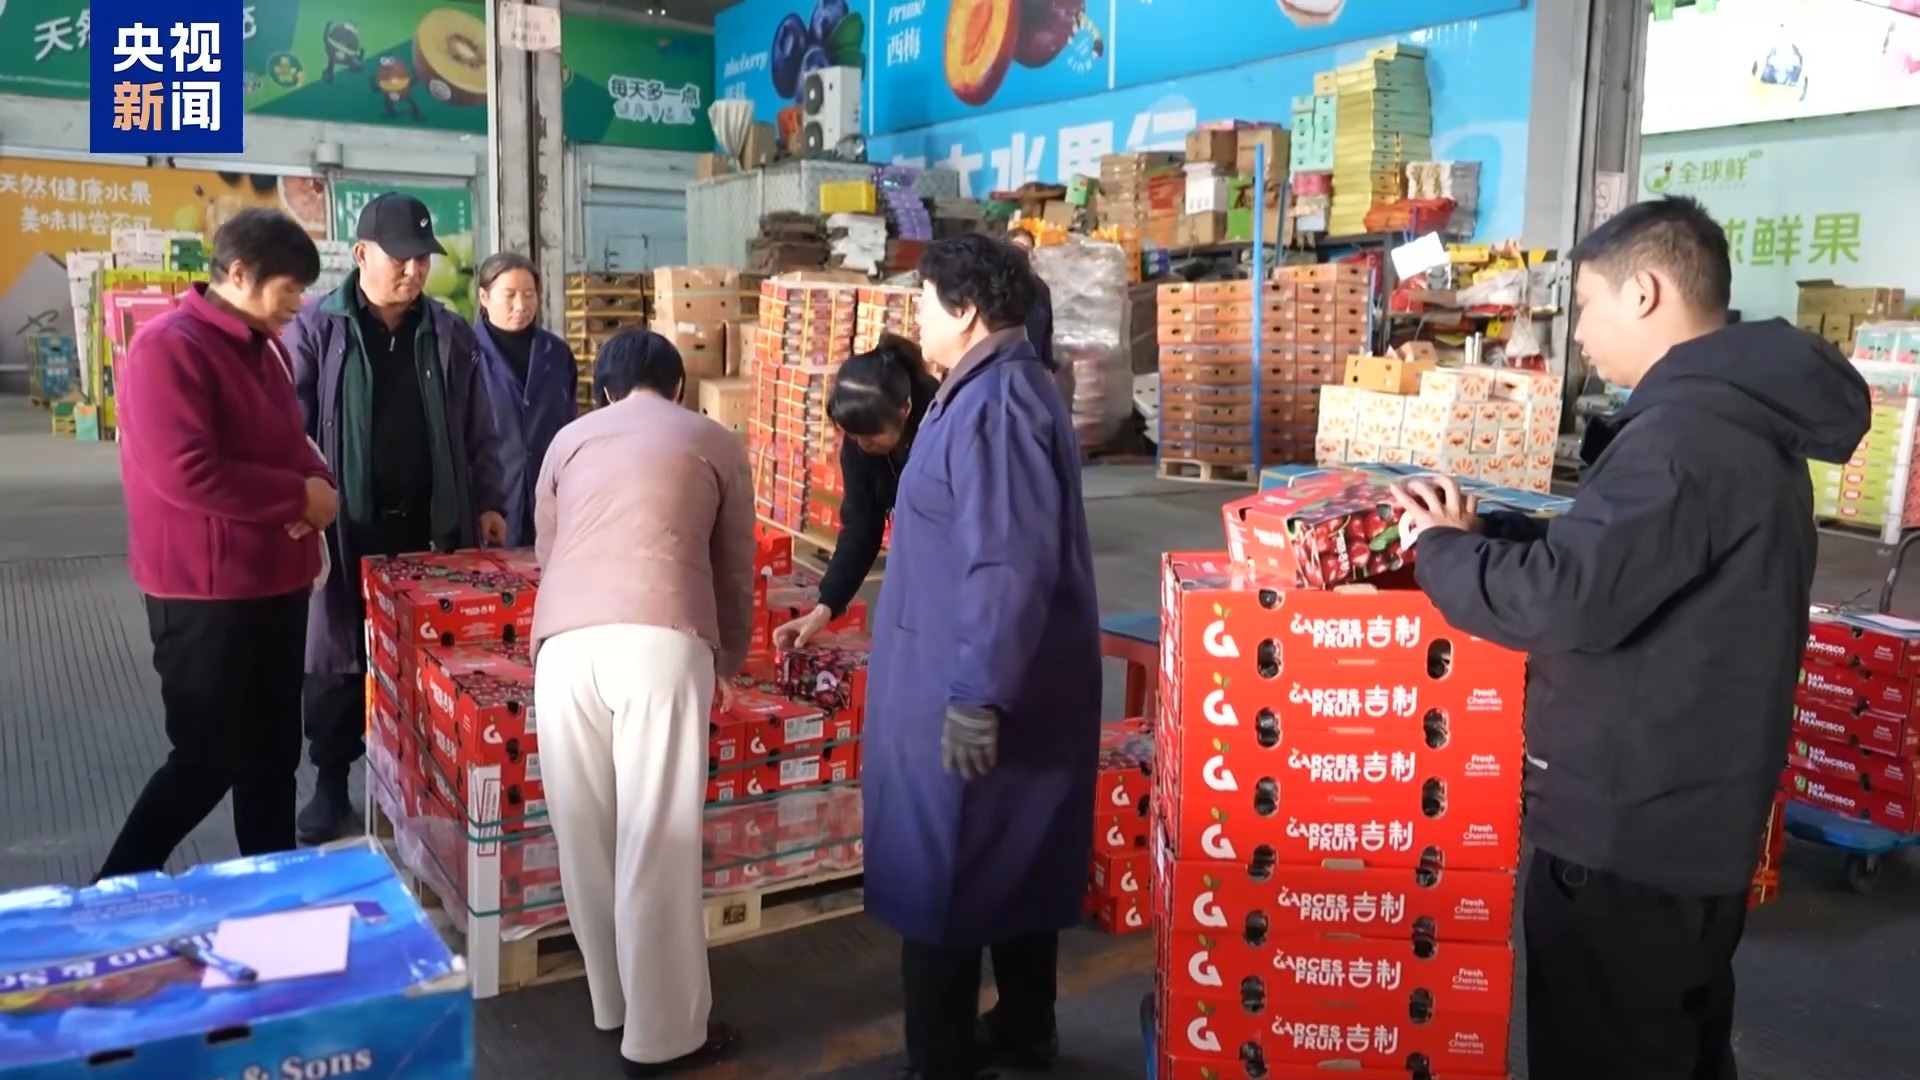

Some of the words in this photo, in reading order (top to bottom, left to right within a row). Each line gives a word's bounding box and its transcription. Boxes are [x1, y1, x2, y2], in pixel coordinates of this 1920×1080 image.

[610, 77, 699, 106] 每天多一点
[1680, 157, 1748, 184] 全球鲜
[0, 173, 152, 205] 天然健康水果
[1290, 613, 1361, 634] GARCES
[1367, 615, 1420, 648] 吉制
[1313, 633, 1364, 648] FRUIT
[1808, 673, 1824, 682] SAN
[1289, 682, 1359, 703] GARCES
[1473, 688, 1497, 697] Fresh
[1808, 681, 1854, 695] FRANCISCO
[1365, 685, 1417, 718] 吉制
[1467, 697, 1502, 705] Cherries
[1312, 702, 1362, 717] FRUIT
[1800, 709, 1817, 719] SAN
[1800, 717, 1845, 733] FRANCISCO
[1288, 748, 1357, 769] GARCES
[1471, 754, 1495, 762] Fresh
[1809, 746, 1825, 757] SAN
[1363, 751, 1415, 782] 吉制
[1465, 763, 1500, 771] Cherries
[1809, 754, 1855, 771] FRANCISCO
[1311, 768, 1360, 782] FRUIT
[1808, 781, 1825, 792] SAN
[1808, 790, 1855, 808] FRANCISCO
[1286, 817, 1355, 838] GARCES
[1361, 820, 1413, 851] 吉制
[1469, 824, 1492, 832] Fresh
[1309, 837, 1358, 851] FRUIT
[1463, 832, 1498, 841] Cherries
[1278, 886, 1347, 908] GARCES
[1461, 898, 1484, 907] Fresh
[1300, 906, 1350, 922] FRUIT
[1353, 891, 1405, 923] 吉制
[1454, 906, 1489, 915] Cherries
[1273, 949, 1342, 972] GARCES
[1295, 970, 1345, 987] FRUIT
[1349, 958, 1401, 990] 吉制
[1452, 976, 1488, 986] Cherries
[1458, 968, 1483, 978] Fresh
[1272, 1016, 1340, 1038] GARCES
[1294, 1036, 1343, 1052] FRUIT
[1347, 1024, 1398, 1055] 吉制
[1448, 1039, 1483, 1048] Cherries
[1455, 1032, 1478, 1041] Fresh
[281, 1048, 373, 1080] Sons
